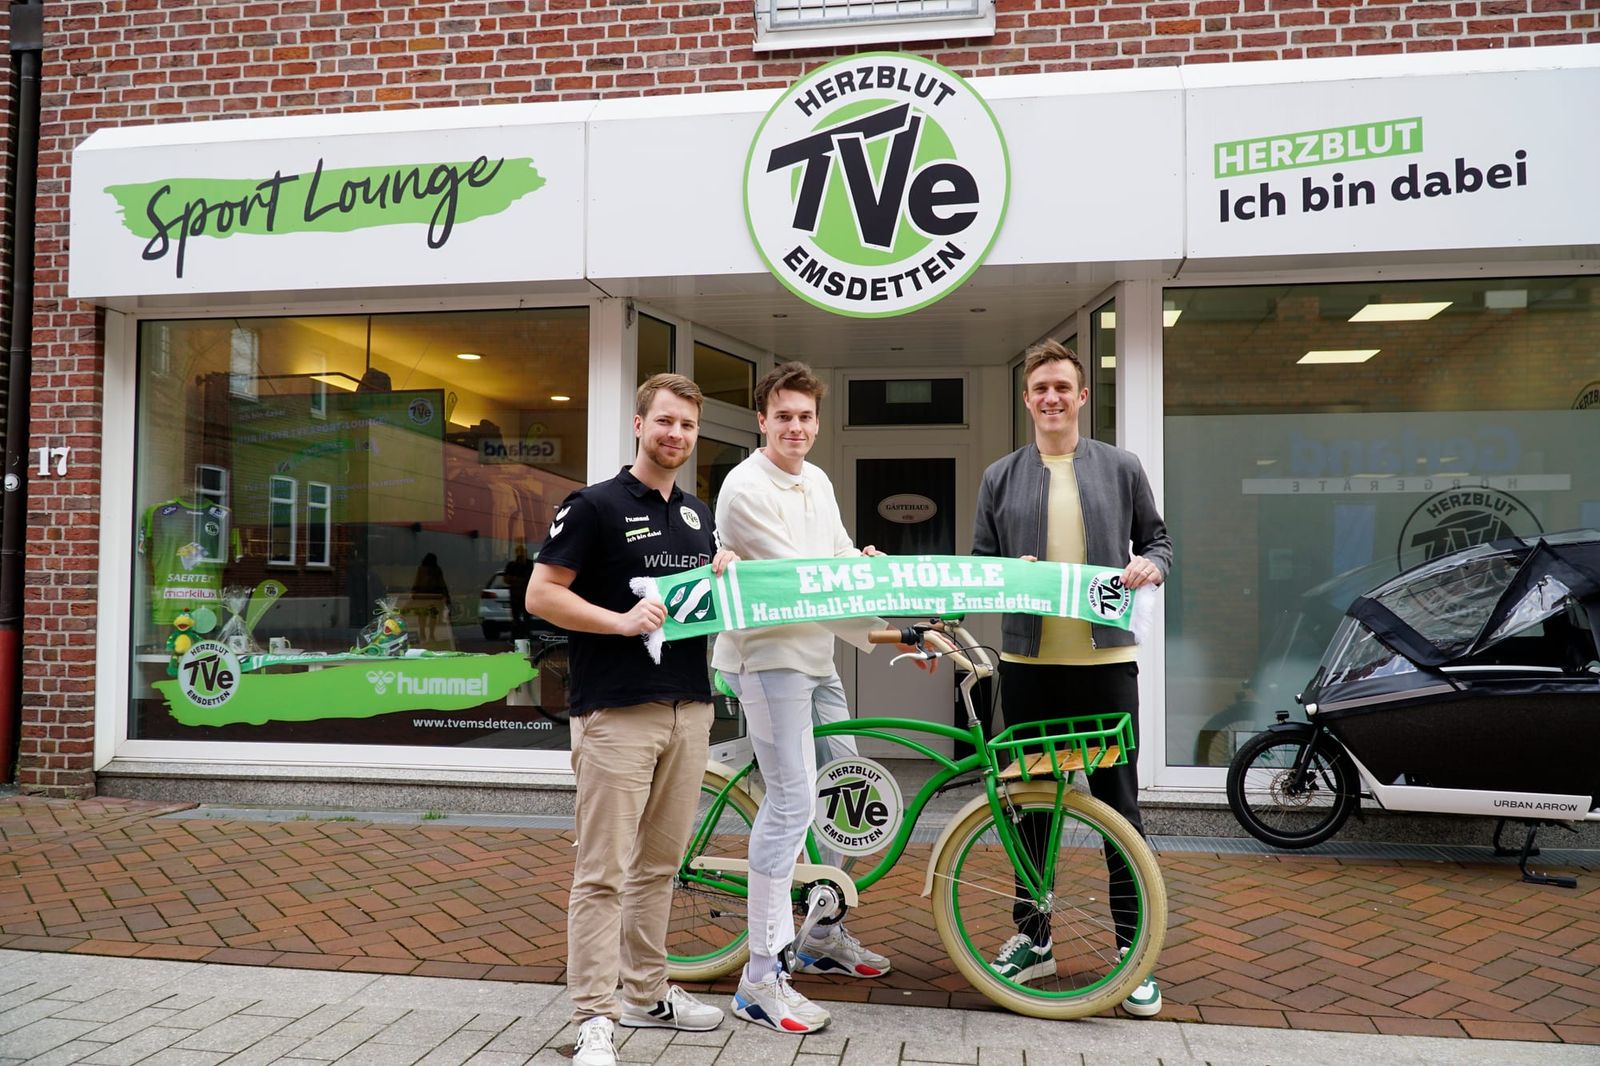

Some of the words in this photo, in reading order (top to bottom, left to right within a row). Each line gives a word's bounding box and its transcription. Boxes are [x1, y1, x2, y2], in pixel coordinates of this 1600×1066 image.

[794, 66, 956, 117] HERZBLUT
[1218, 122, 1417, 174] HERZBLUT
[766, 103, 980, 248] TVe
[1220, 183, 1286, 222] Ich
[1302, 173, 1375, 213] bin
[1391, 150, 1527, 200] dabei
[141, 170, 299, 279] Sport
[304, 155, 504, 249] Lounge
[783, 241, 966, 301] EMSDETTEN
[37, 446, 71, 476] 17
[886, 503, 929, 511] GÄSTEHAUS
[1426, 493, 1518, 518] HERZBLUT
[644, 551, 698, 568] WÜLLER
[796, 556, 1004, 593] EMS-HÖLLE
[751, 592, 946, 623] Handball-Hochburg
[951, 592, 1052, 613] Emsdetten
[190, 643, 229, 656] HERZBLUT
[184, 654, 234, 691] TVe
[397, 671, 488, 697] hummel
[187, 690, 230, 706] EMSDETTEN
[413, 717, 553, 732] www.tvemsdetten.com
[828, 765, 881, 782] HERZBLUT
[818, 780, 889, 828] TVe
[1494, 800, 1533, 809] URBAN
[1535, 802, 1576, 811] ARROW
[823, 824, 883, 846] EMSDETTEN
